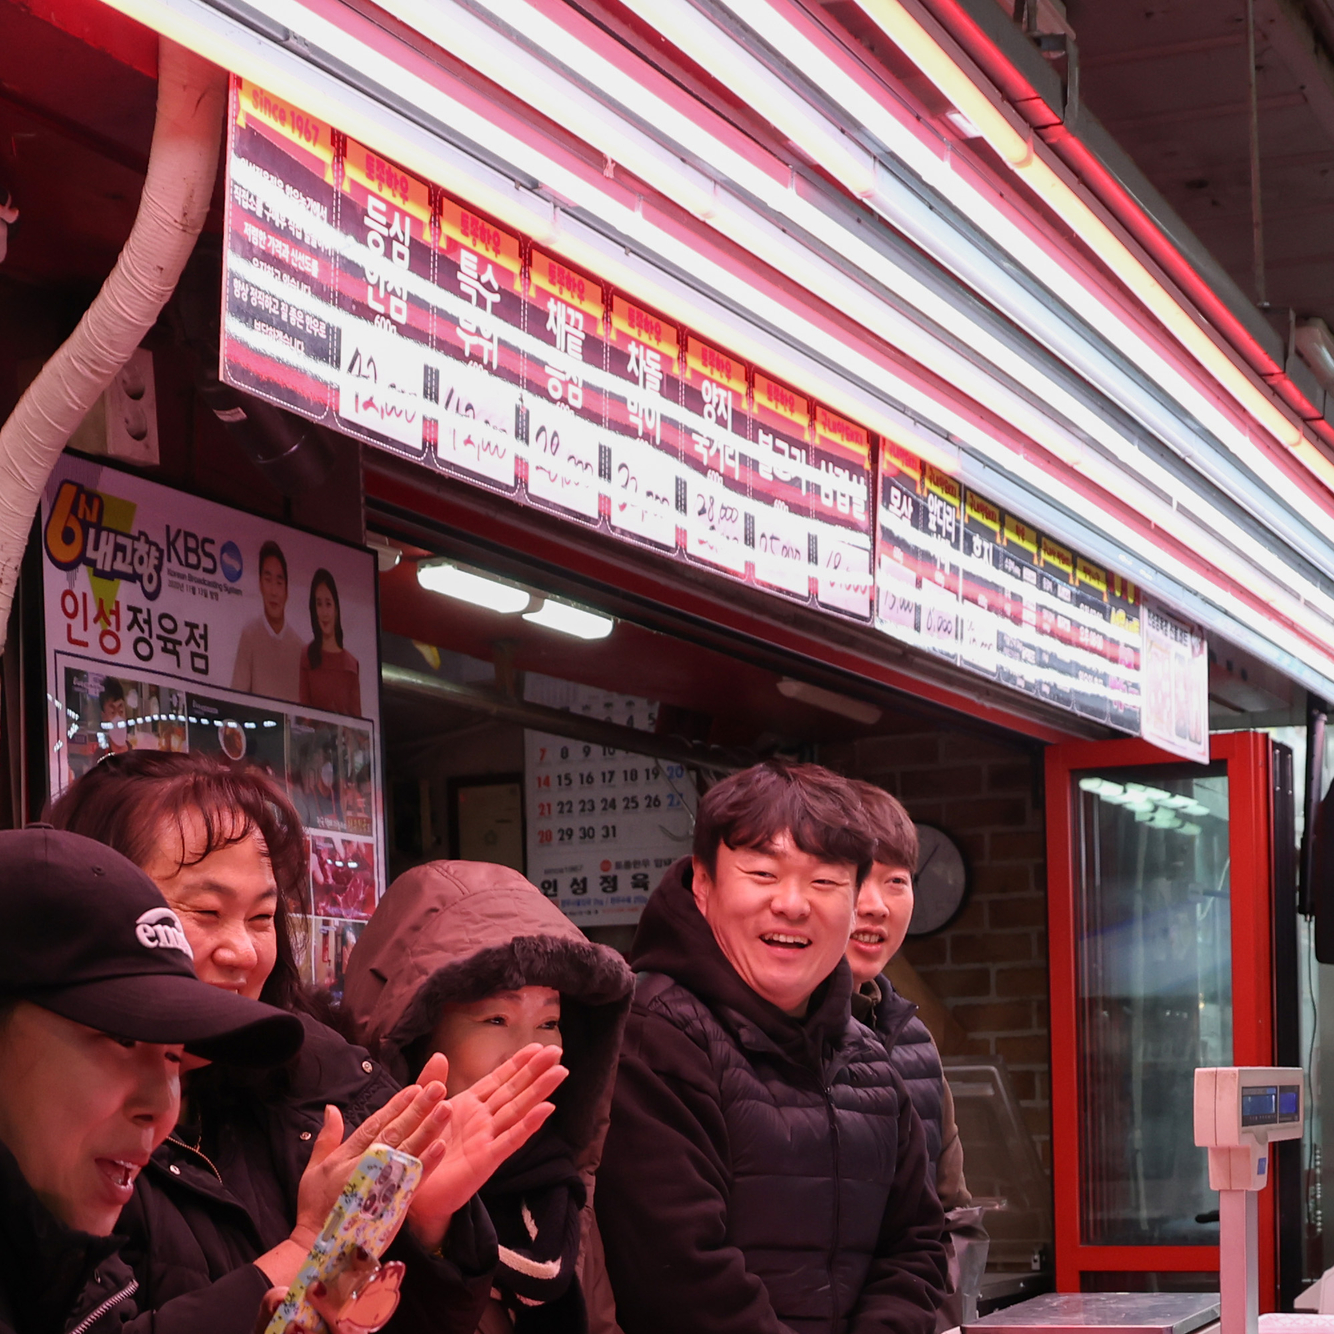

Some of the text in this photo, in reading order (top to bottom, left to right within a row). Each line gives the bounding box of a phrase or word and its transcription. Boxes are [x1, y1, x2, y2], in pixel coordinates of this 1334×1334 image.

[250, 89, 321, 147] since 1967
[363, 193, 411, 270] 등심
[456, 248, 501, 314] 특수
[545, 297, 586, 361] 채끝
[626, 340, 663, 397] 차돌
[700, 379, 733, 432] 양지
[927, 493, 956, 543] 앞다리
[165, 524, 217, 575] KBS
[60, 588, 210, 676] 인성정육점
[537, 765, 683, 788] 14 15 16 17 18 19 20
[539, 748, 547, 760] 7
[561, 746, 568, 759] 8
[582, 746, 591, 758] 9
[538, 803, 551, 816] 21
[557, 802, 573, 814] 22
[579, 800, 594, 813] 23
[601, 798, 616, 812] 24
[622, 797, 639, 810] 25
[644, 795, 661, 808] 26
[558, 828, 573, 842] 29
[579, 827, 595, 840] 30
[602, 825, 616, 838] 31
